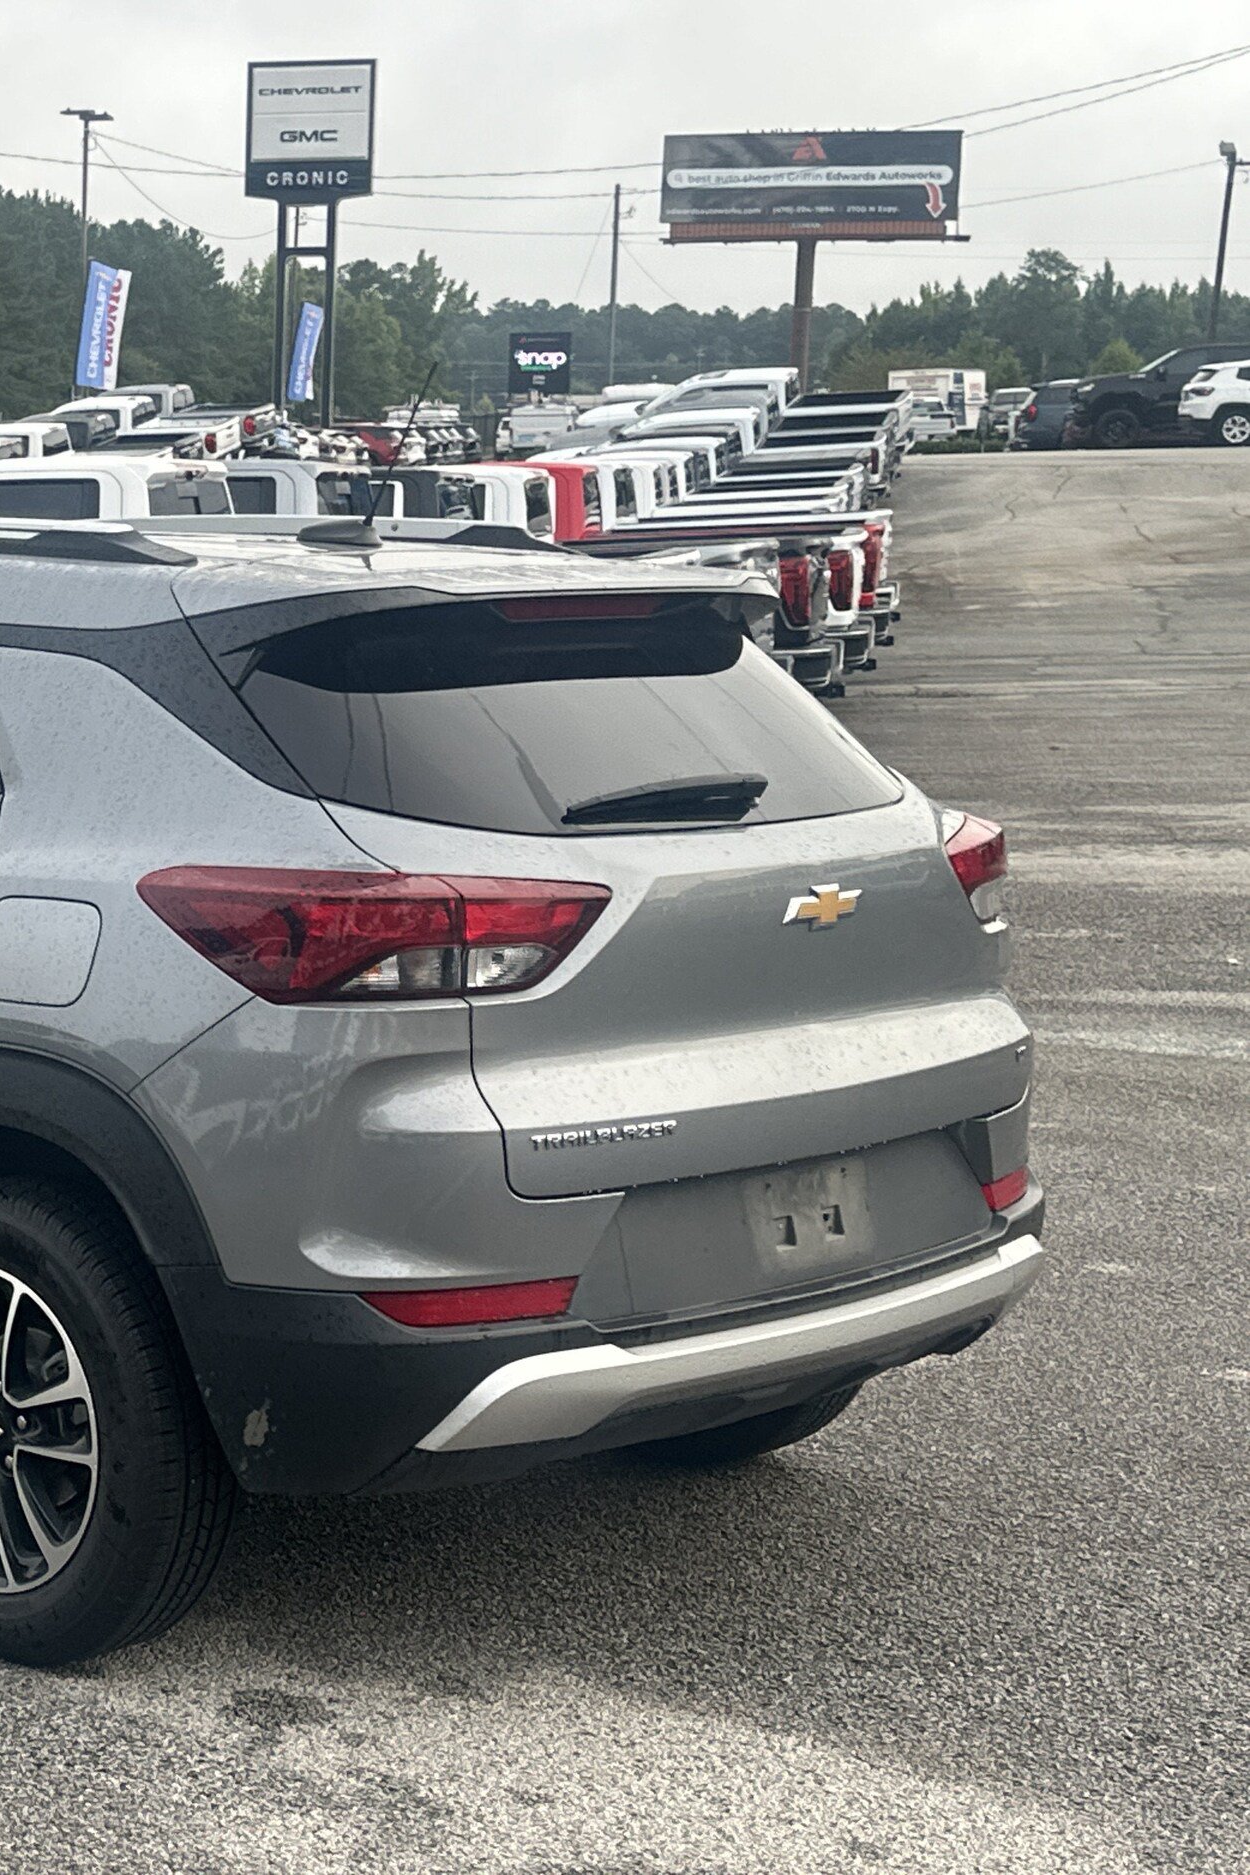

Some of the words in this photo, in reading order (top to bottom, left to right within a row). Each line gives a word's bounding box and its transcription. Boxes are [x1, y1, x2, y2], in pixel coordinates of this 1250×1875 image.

[258, 86, 362, 96] CHEVROLET
[280, 129, 338, 143] GMC
[266, 170, 349, 186] CRONIC
[825, 171, 876, 182] Edwards
[879, 171, 943, 182] Autoworks
[86, 280, 107, 378] CHEVROLET
[530, 1120, 677, 1150] TRAILBLAZER
